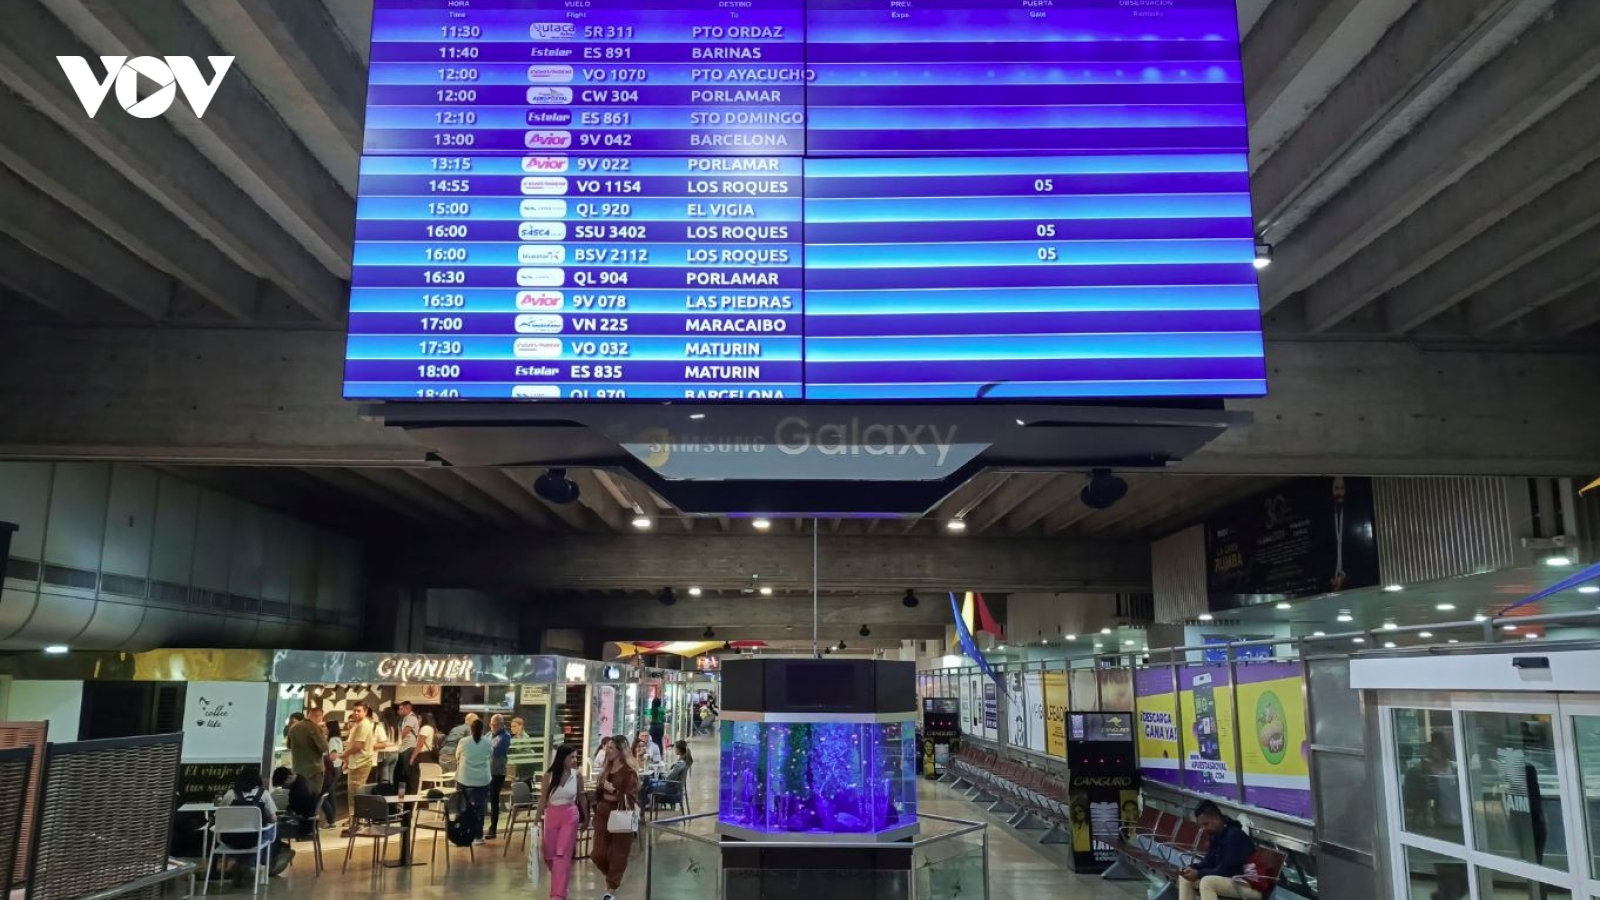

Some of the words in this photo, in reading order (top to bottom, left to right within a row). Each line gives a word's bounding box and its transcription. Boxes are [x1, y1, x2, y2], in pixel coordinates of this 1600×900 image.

[566, 11, 587, 19] Flight
[730, 11, 739, 19] To
[1029, 10, 1046, 18] Gate
[440, 26, 481, 39] 11:30
[584, 26, 603, 38] 5R
[606, 26, 636, 38] 311
[692, 26, 725, 38] PTO
[727, 26, 783, 38] ORDAZ
[438, 46, 479, 59] 11:40
[583, 47, 602, 58] ES
[605, 47, 630, 58] 891
[692, 47, 761, 59] BARINAS
[437, 68, 478, 80] 12:00
[583, 69, 606, 81] VO
[610, 69, 646, 81] 1070
[691, 69, 724, 81] PTO
[725, 69, 816, 81] AYACUCHO
[436, 90, 477, 102] 12:00
[582, 90, 608, 102] CW
[611, 90, 639, 102] 304
[691, 90, 781, 102] PORLAMAR
[434, 112, 476, 124] 12:10
[581, 112, 600, 124] ES
[603, 112, 629, 124] 861
[690, 112, 721, 124] STO
[724, 112, 805, 125] DOMINGO
[433, 134, 475, 146] 13:00
[529, 133, 569, 146] Avior
[580, 134, 602, 146] 9V
[604, 134, 632, 146] 042
[690, 134, 787, 146] BARCELONA
[430, 158, 471, 170] 13:15
[526, 156, 567, 169] Avior
[577, 158, 599, 171] 9V
[601, 158, 630, 171] 022
[687, 158, 780, 171] PORLAMAR
[428, 180, 470, 192] 14:55
[576, 181, 601, 193] VO
[605, 181, 642, 193] 1154
[687, 181, 718, 193] LOS
[722, 181, 788, 194] ROQUES
[1034, 179, 1053, 191] 05
[428, 203, 469, 215] 15:00
[576, 203, 599, 217] QL
[602, 203, 630, 216] 920
[687, 204, 706, 216] EL
[709, 204, 755, 216] VIGIA
[426, 225, 468, 238] 16:00
[575, 225, 606, 238] SSU
[609, 225, 647, 239] 3402
[686, 226, 718, 239] LOS
[721, 226, 788, 240] ROQUES
[1036, 224, 1055, 237] 05
[425, 248, 467, 261] 16:00
[575, 249, 608, 262] BSV
[611, 249, 648, 262] 2112
[686, 249, 718, 262] LOS
[721, 249, 788, 264] ROQUES
[1037, 247, 1056, 260] 05
[423, 271, 465, 284] 16:30
[573, 272, 597, 286] QL
[599, 271, 628, 285] 904
[686, 272, 779, 285] PORLAMAR
[422, 294, 464, 307] 16:30
[520, 294, 561, 307] Avior
[572, 295, 595, 307] 9V
[597, 295, 626, 308] 078
[685, 296, 717, 308] LAS
[720, 296, 792, 309] PIEDRAS
[420, 317, 463, 330] 17:00
[571, 318, 597, 331] VN
[599, 318, 628, 331] 225
[685, 318, 787, 332] MARACAIBO
[419, 341, 462, 354] 17:30
[571, 342, 596, 355] VO
[599, 342, 628, 355] 032
[685, 343, 761, 356] MATURIN
[417, 365, 460, 378] 18:00
[570, 366, 591, 378] ES
[593, 366, 623, 378] 835
[684, 366, 760, 379] MATURIN
[648, 433, 766, 454] SAMSUNG
[774, 416, 958, 467] Galaxy
[205, 705, 228, 717] coffee
[201, 765, 233, 778] viaje
[186, 783, 203, 793] tus
